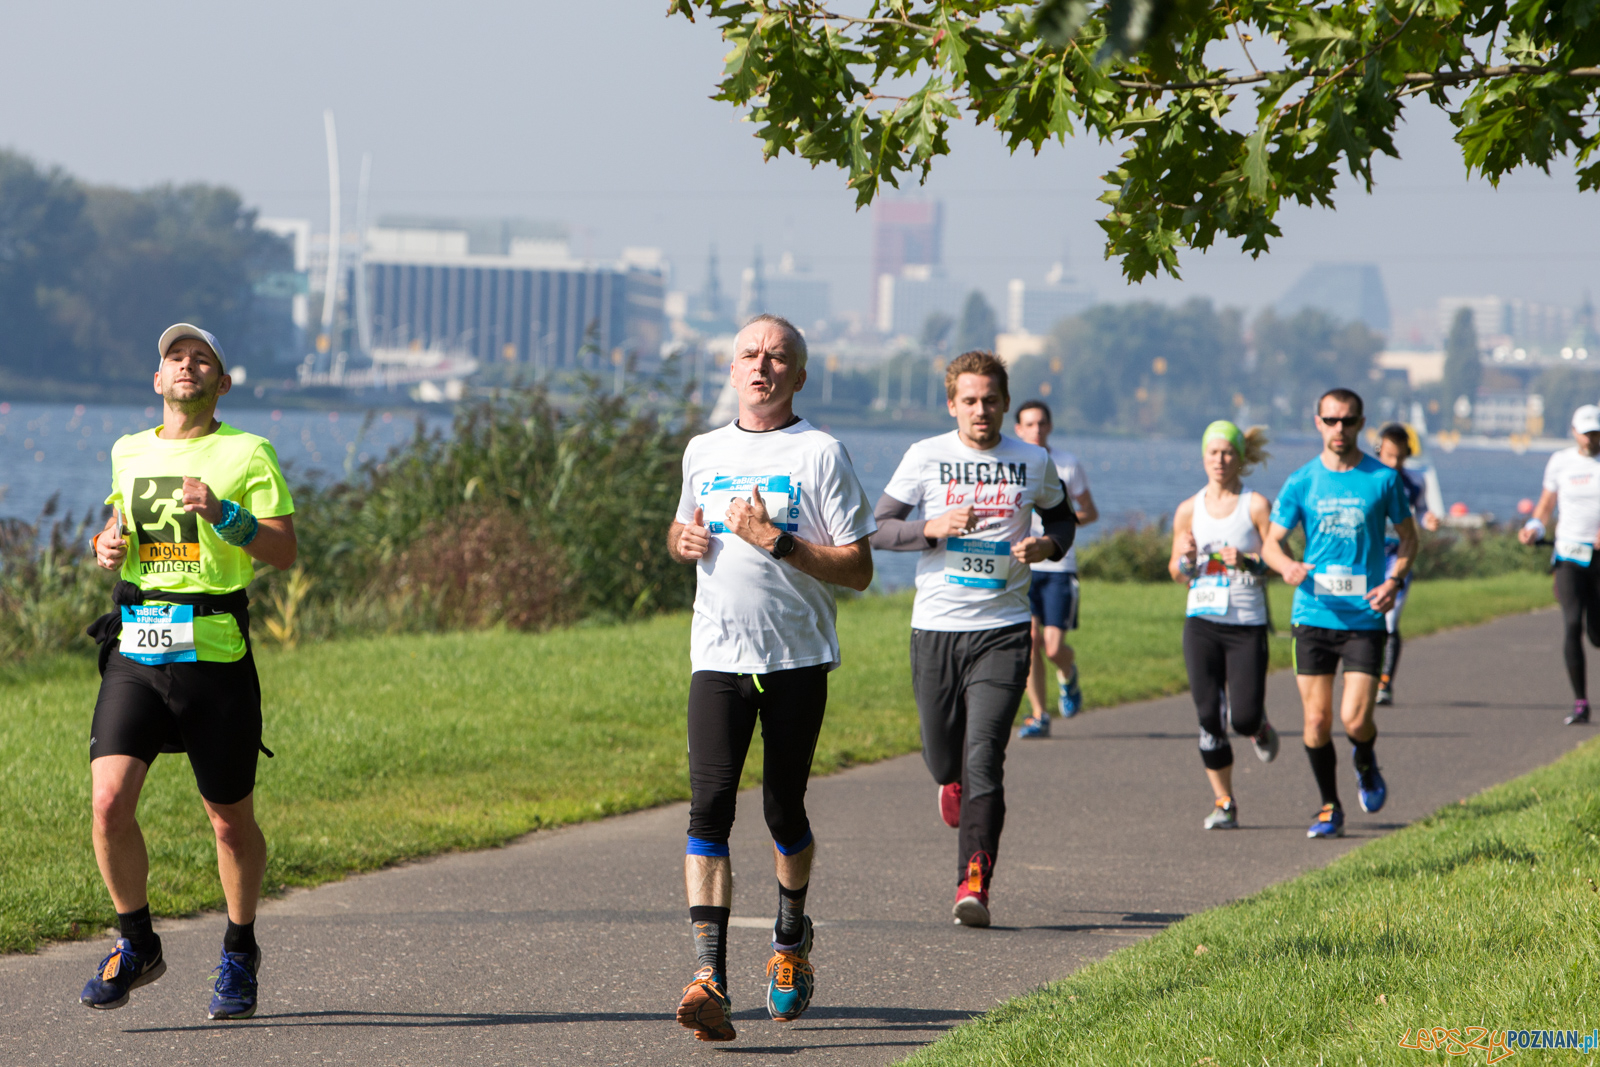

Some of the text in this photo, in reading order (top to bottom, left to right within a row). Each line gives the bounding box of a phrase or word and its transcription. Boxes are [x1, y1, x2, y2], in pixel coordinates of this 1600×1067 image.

[940, 462, 1027, 486] BIEGAM
[946, 479, 968, 506] bo
[149, 543, 188, 559] night
[141, 559, 200, 574] runners
[962, 557, 995, 575] 335
[137, 628, 173, 648] 205
